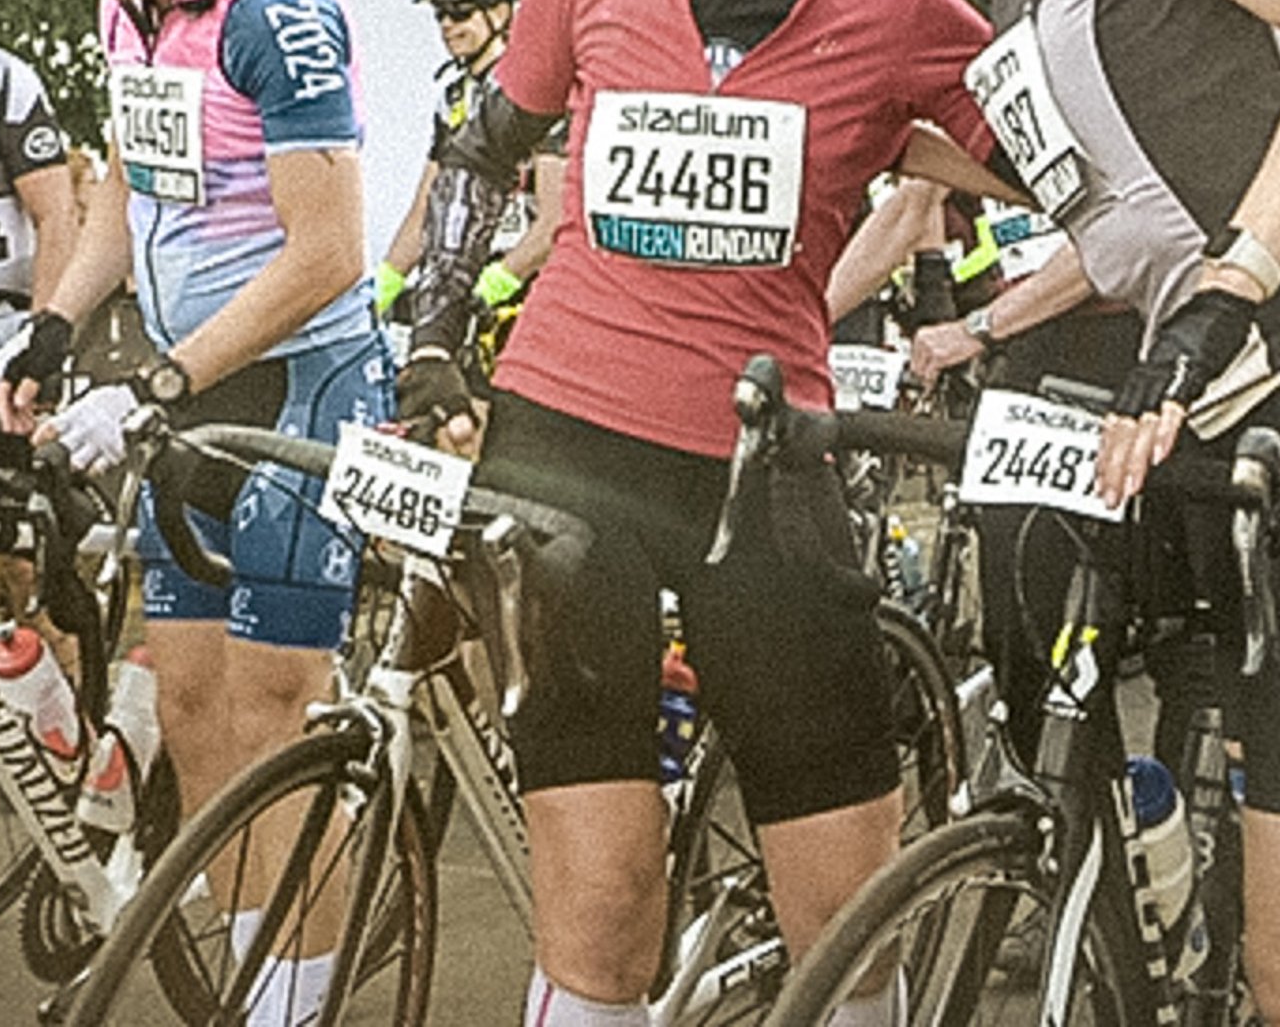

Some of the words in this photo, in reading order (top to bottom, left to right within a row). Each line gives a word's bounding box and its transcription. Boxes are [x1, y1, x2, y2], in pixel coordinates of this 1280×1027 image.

[121, 105, 188, 159] 24450
[618, 101, 770, 141] stadium
[606, 145, 772, 215] 24486
[333, 466, 443, 538] 24486
